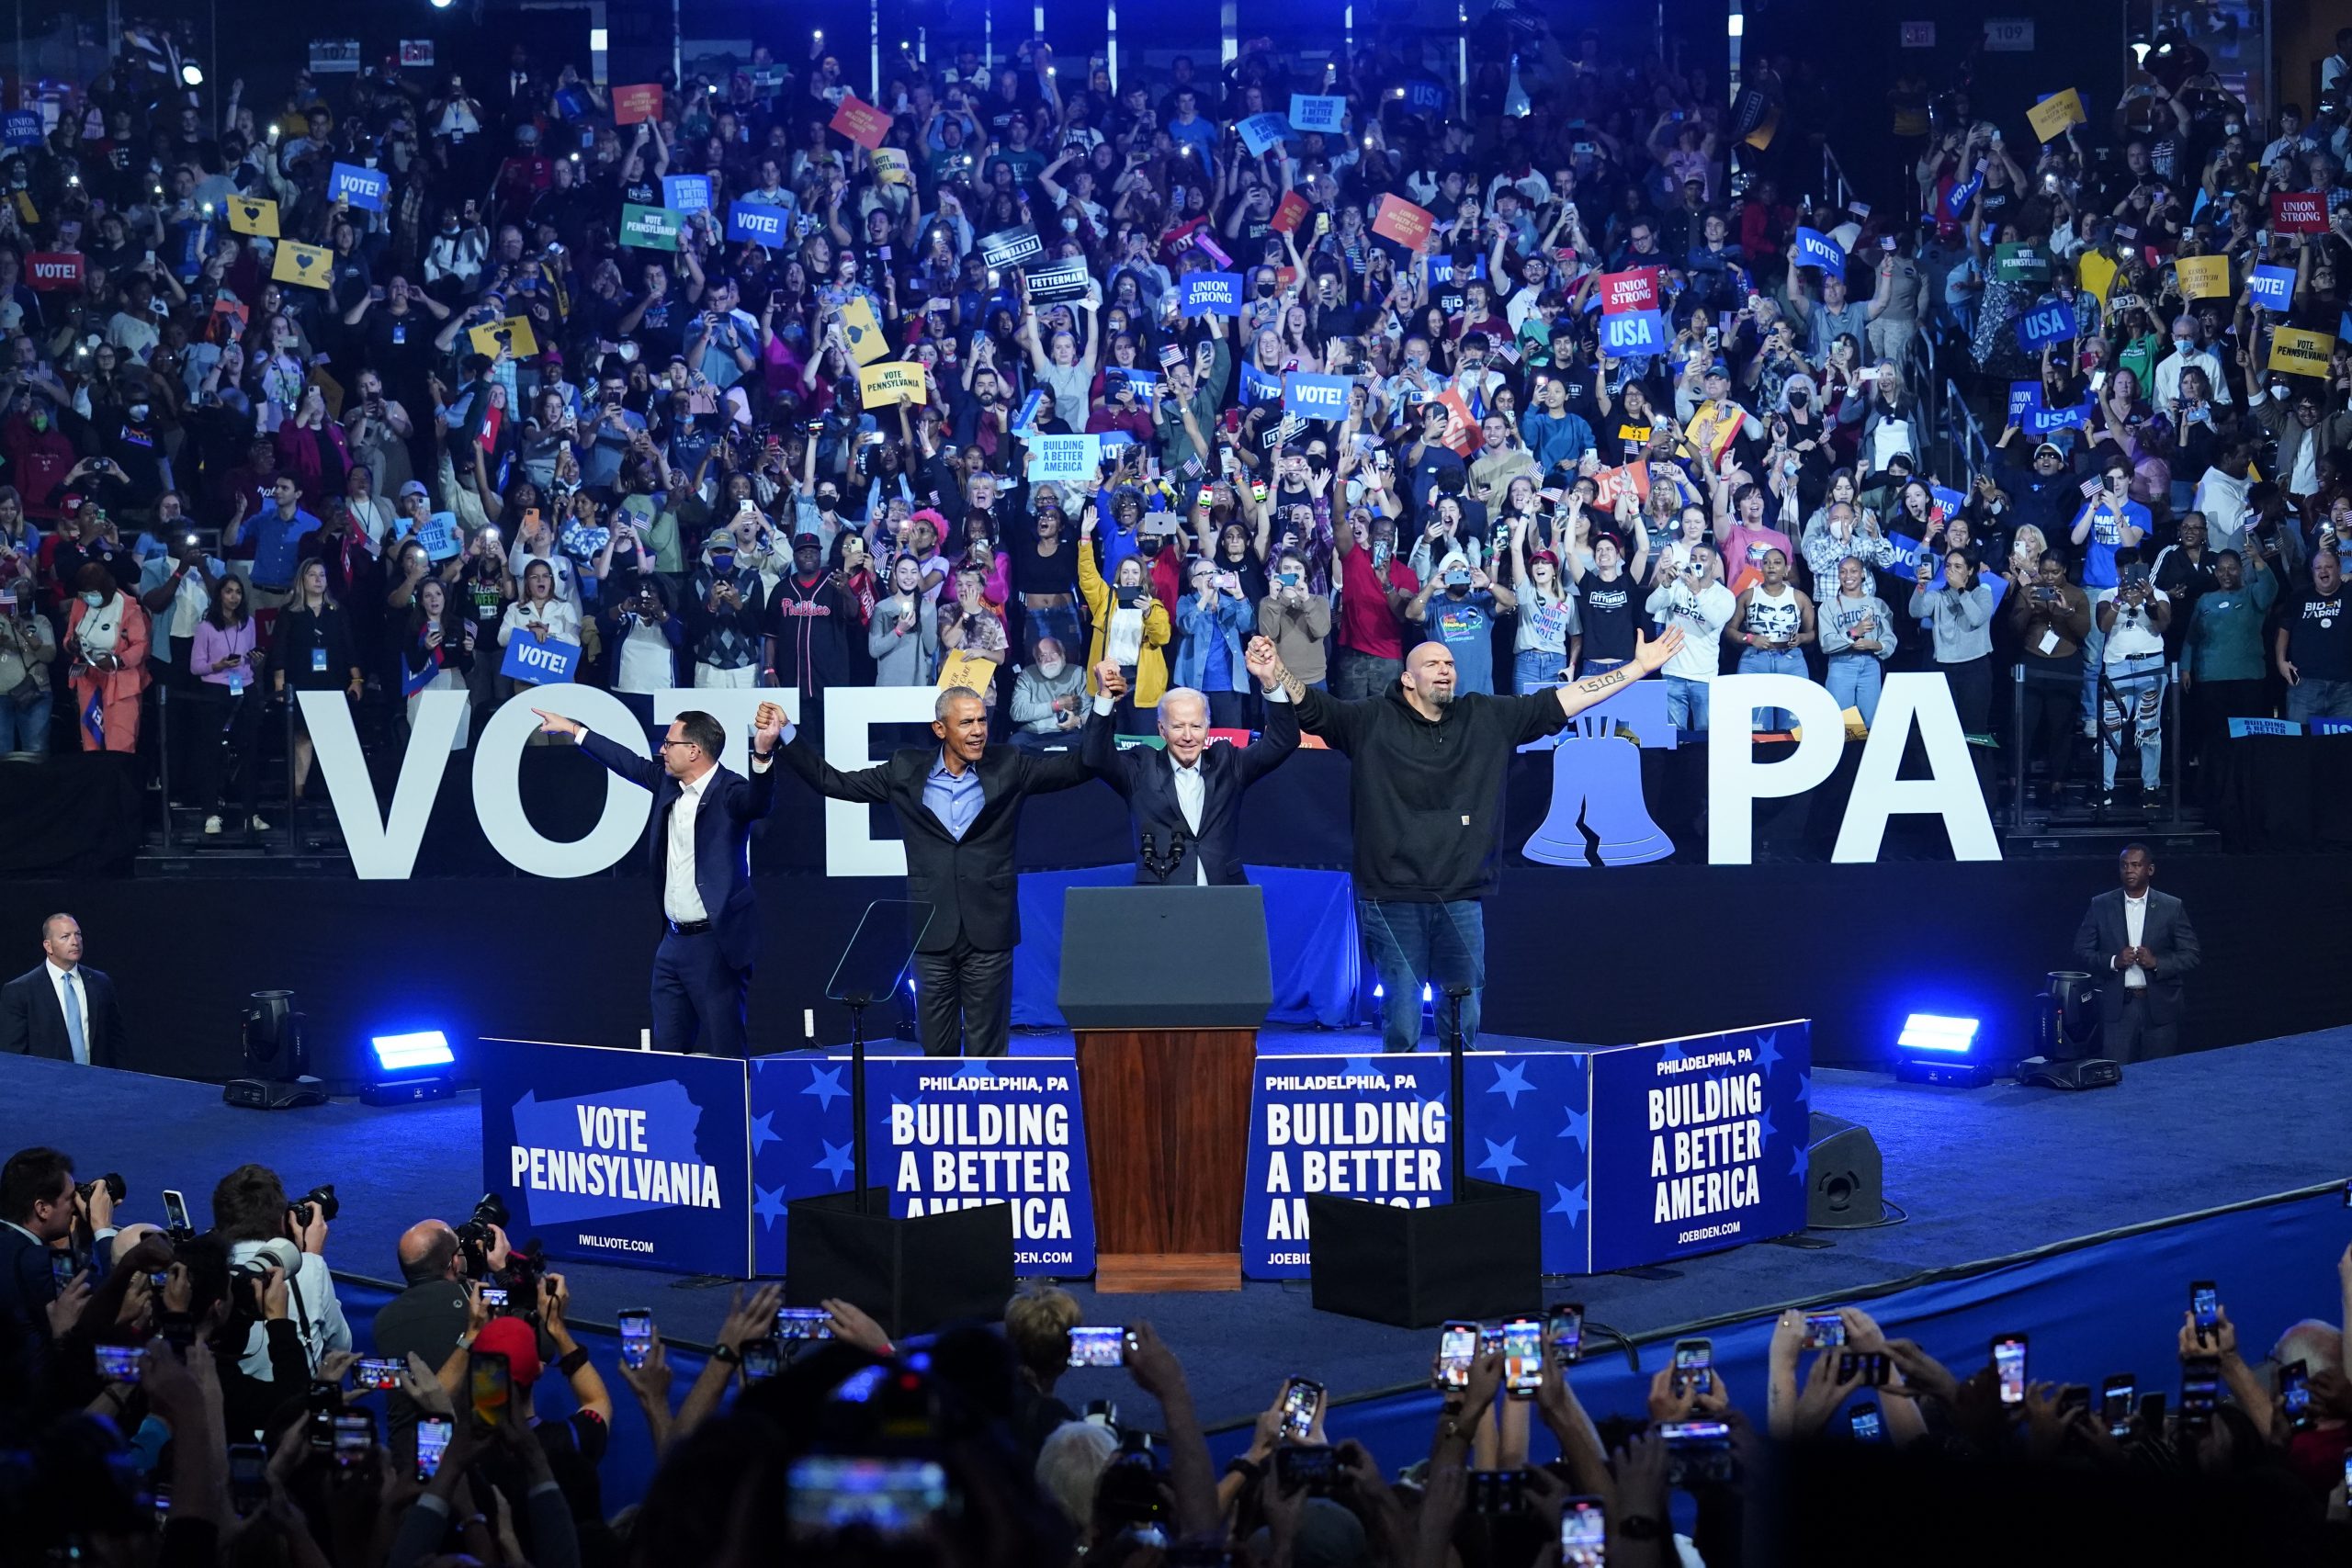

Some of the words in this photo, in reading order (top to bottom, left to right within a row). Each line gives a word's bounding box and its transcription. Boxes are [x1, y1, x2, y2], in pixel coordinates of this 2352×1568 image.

[7, 118, 35, 127] UNION
[6, 127, 40, 137] STRONG
[340, 175, 379, 197] VOTE!
[2282, 201, 2315, 213] UNION
[644, 214, 662, 225] VOTE
[737, 212, 778, 233] VOTE!
[2280, 210, 2320, 222] STRONG
[627, 221, 676, 237] PENNSYLVANIA
[1805, 237, 1839, 266] VOTE!
[2018, 249, 2034, 258] VOTE
[35, 264, 76, 279] VOTE!
[2002, 258, 2047, 268] PENNSYLVANIA
[1031, 271, 1083, 288] FETTERMAN
[1192, 281, 1228, 293] UNION
[1613, 278, 1648, 294] UNION
[2252, 274, 2284, 295] VOTE!
[1189, 292, 1232, 305] STRONG
[1611, 290, 1652, 305] STRONG
[1610, 318, 1653, 346] USA
[2025, 310, 2066, 339] USA
[2296, 338, 2314, 350] VOTE
[2277, 344, 2328, 364] PENNSYLVANIA
[884, 370, 902, 380] VOTE
[867, 378, 920, 392] PENNSYLVANIA
[1295, 384, 1341, 405] VOTE!
[2035, 410, 2078, 428] USA
[1043, 441, 1084, 451] BUILDING
[1043, 452, 1049, 461] A
[1052, 451, 1083, 461] BETTER
[1044, 461, 1083, 472] AMERICA
[424, 540, 447, 552] ERICA
[474, 593, 500, 605] WEED
[781, 598, 831, 617] Phillies
[1673, 604, 1706, 623] EDGE
[1532, 614, 1562, 632] CHOICE
[517, 643, 568, 674] VOTE!
[1578, 671, 1627, 694] 15104
[2245, 720, 2286, 729] BUILDING
[1708, 672, 2003, 865] PA
[1657, 1052, 1736, 1076] PHILADELPHIA,
[1737, 1048, 1753, 1063] PA
[919, 1077, 1043, 1093] PHILADELPHIA,
[1046, 1077, 1069, 1091] PA
[1266, 1075, 1390, 1091] PHILADELPHIA,
[1395, 1075, 1417, 1089] PA
[1648, 1072, 1762, 1131] BUILDING
[577, 1105, 648, 1153] VOTE
[891, 1103, 1069, 1145] BUILDING
[1266, 1100, 1446, 1145] BUILDING
[1651, 1135, 1668, 1178] A
[1675, 1119, 1761, 1174] BETTER
[511, 1145, 721, 1209] PENNSYLVANIA
[897, 1151, 921, 1192] A
[933, 1151, 1070, 1192] BETTER
[1266, 1151, 1292, 1193] A
[1303, 1149, 1442, 1192] BETTER
[1654, 1165, 1760, 1224] AMERICA
[1678, 1221, 1740, 1244] JOEBIDEN.COM
[579, 1234, 654, 1253] IWILLVOTE.COM
[1013, 1251, 1072, 1264] DEN.COM
[1267, 1252, 1312, 1265] JOEBID
